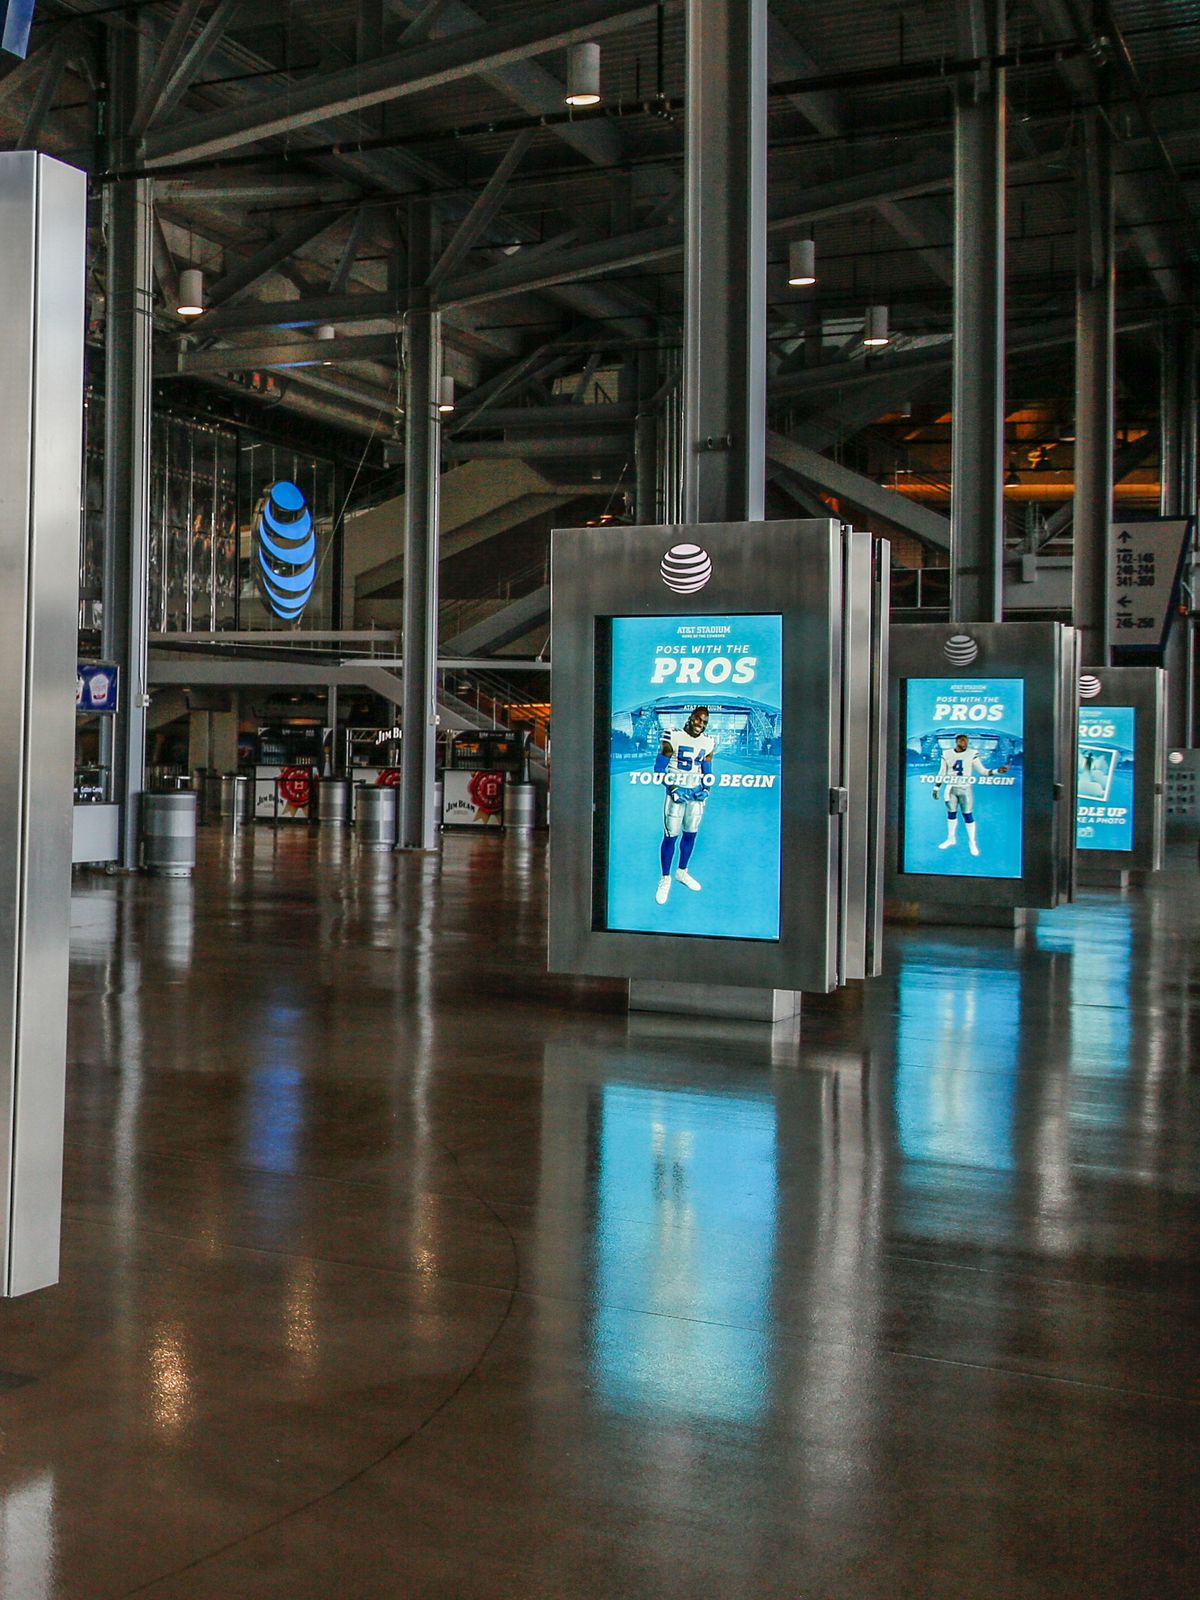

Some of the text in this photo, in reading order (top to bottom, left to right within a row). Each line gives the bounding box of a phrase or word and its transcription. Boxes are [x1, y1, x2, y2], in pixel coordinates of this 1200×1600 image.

[677, 625, 731, 634] AT&T STADIUM
[656, 645, 750, 654] POSE WITH THE
[650, 657, 757, 684] PROS
[932, 704, 1004, 721] PROS
[376, 729, 392, 745] JIM
[1079, 725, 1116, 738] ROS
[952, 760, 963, 776] 4
[629, 772, 776, 788] TOUCH TO BEGIN
[920, 775, 1015, 785] TOUCH TO BEGIN
[445, 802, 458, 813] JIM
[458, 800, 475, 813] BEAM
[1078, 806, 1127, 818] DLE UP
